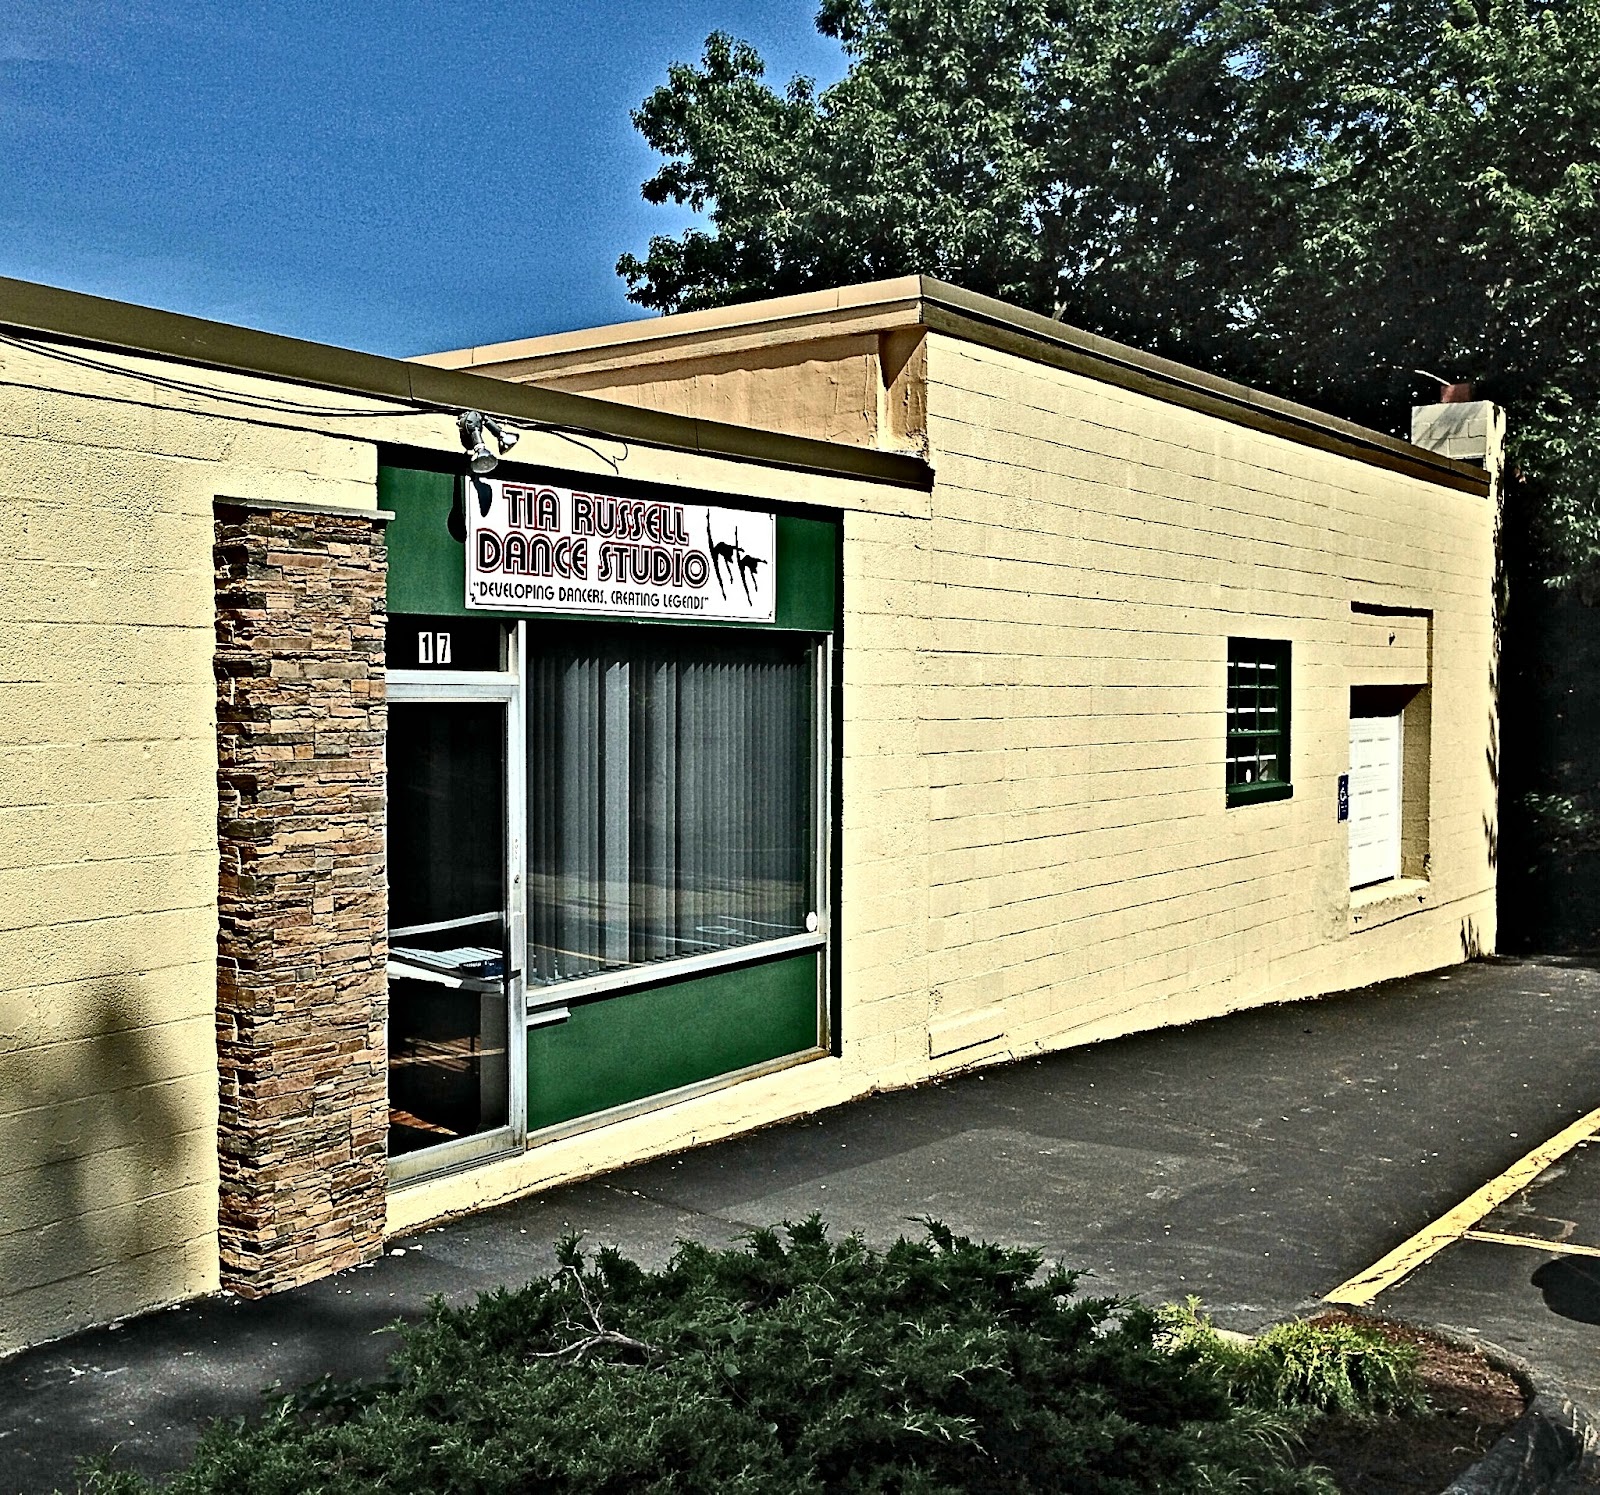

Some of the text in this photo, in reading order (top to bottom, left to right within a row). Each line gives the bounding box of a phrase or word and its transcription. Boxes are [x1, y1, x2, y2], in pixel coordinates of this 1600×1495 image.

[502, 484, 689, 546] TIA RUSSELL
[476, 528, 710, 589] DANCE STUDIO
[611, 591, 660, 607] CREATING
[422, 633, 448, 662] 17
